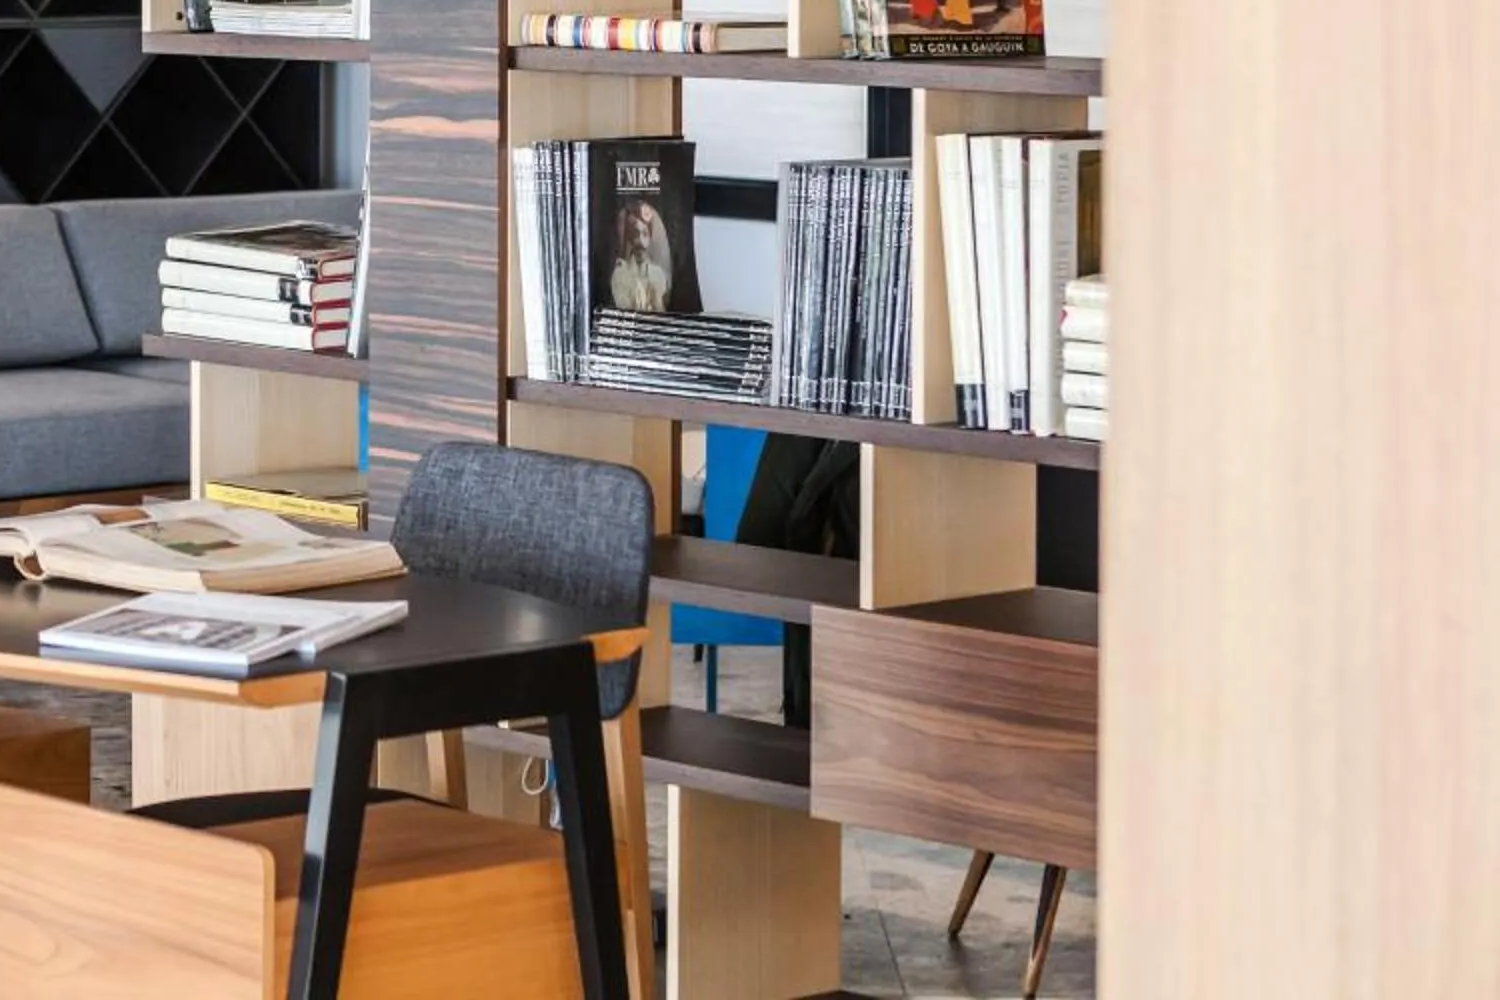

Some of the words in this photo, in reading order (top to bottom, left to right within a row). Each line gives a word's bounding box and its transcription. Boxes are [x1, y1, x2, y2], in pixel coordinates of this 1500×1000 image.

[909, 42, 925, 53] DE
[928, 42, 958, 53] GOYA
[616, 166, 648, 187] FMR
